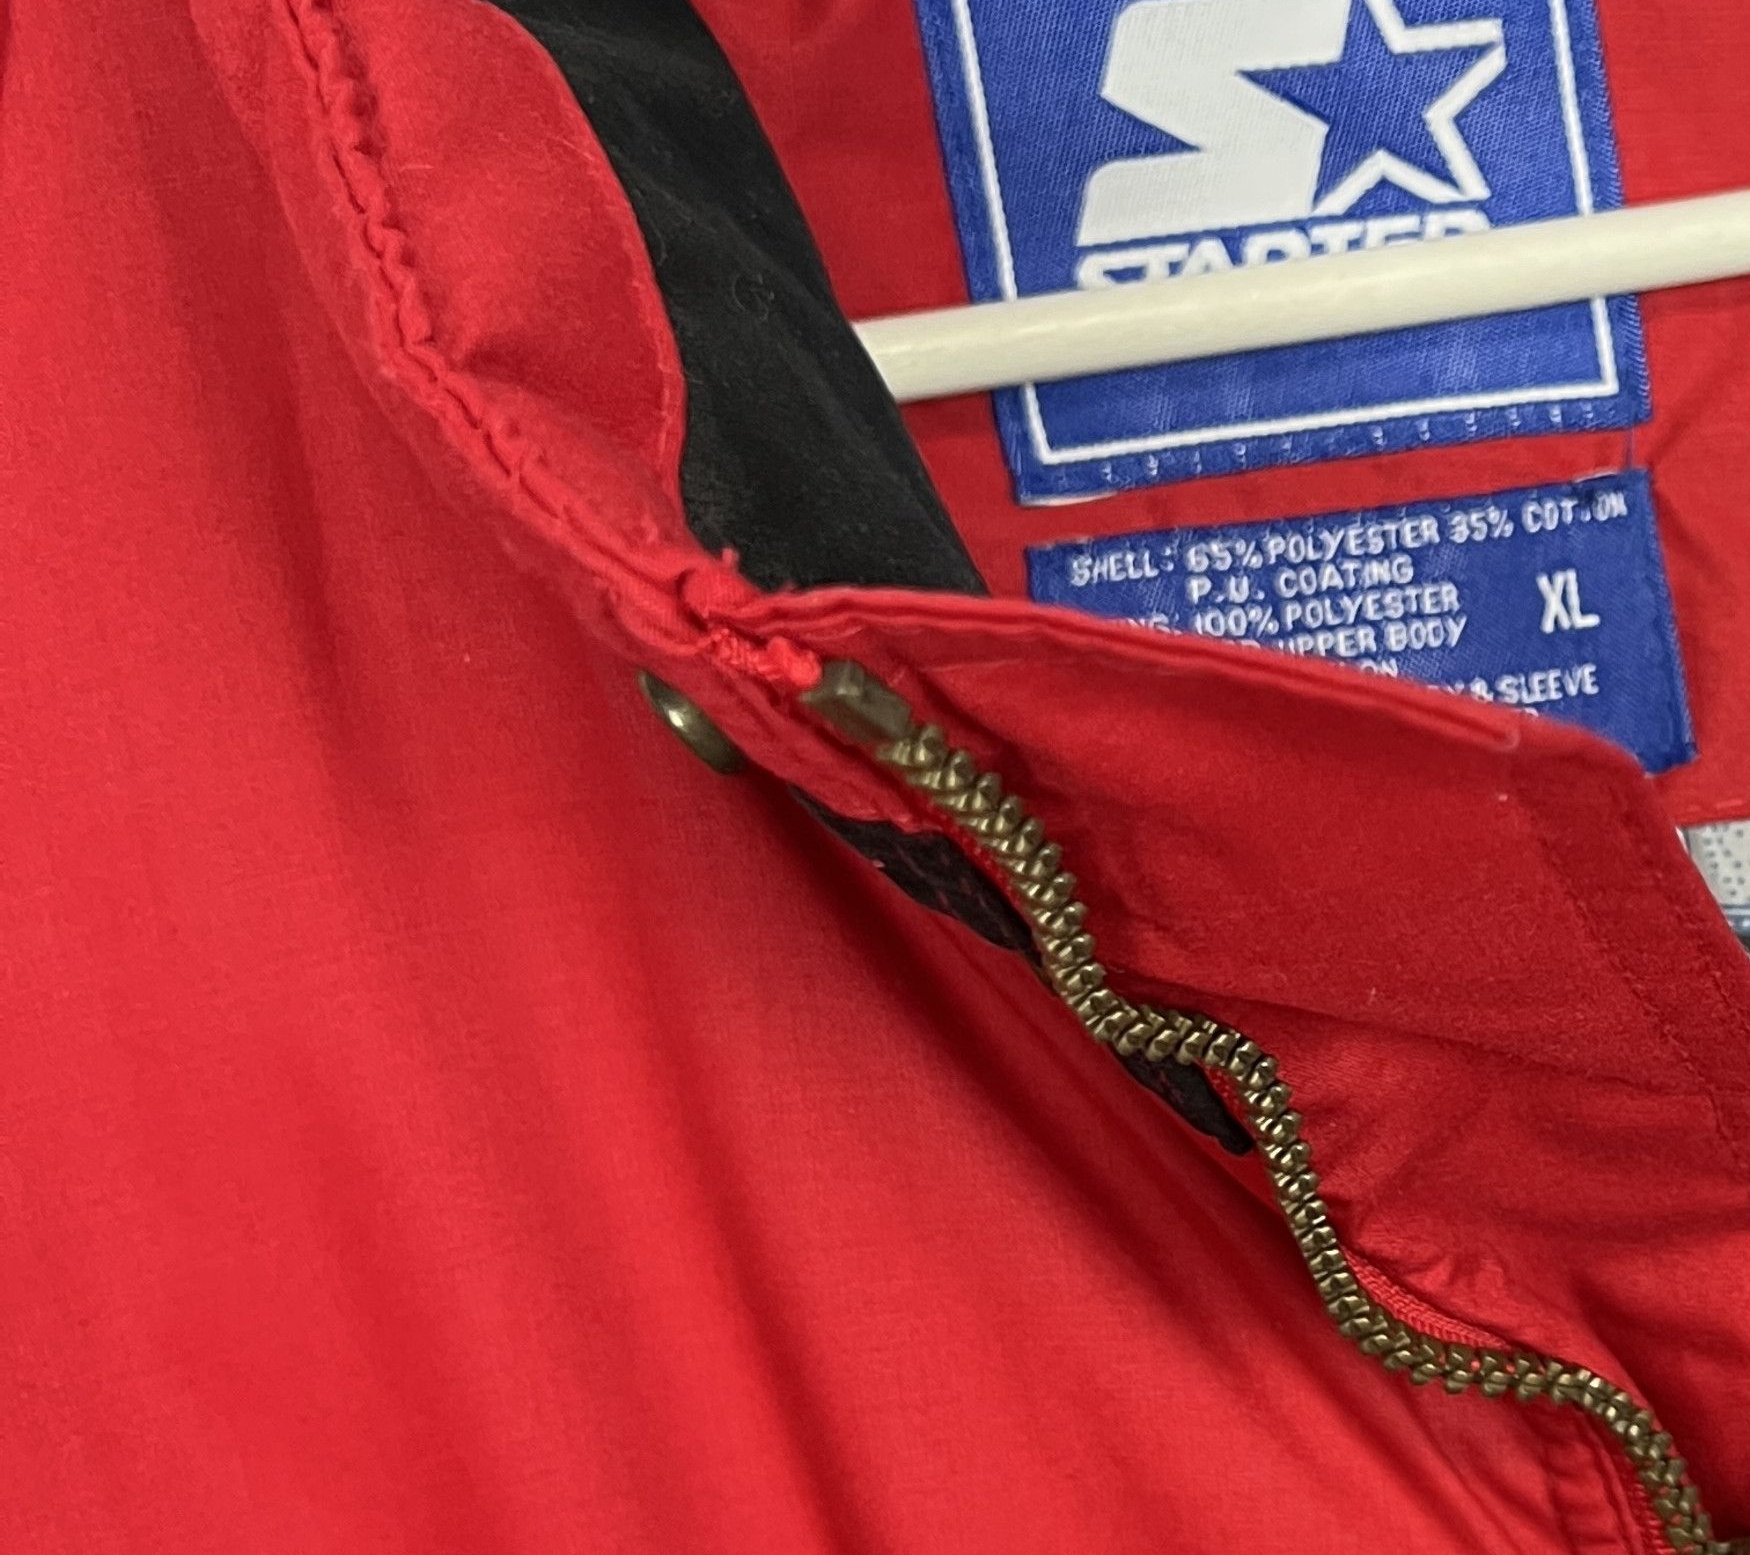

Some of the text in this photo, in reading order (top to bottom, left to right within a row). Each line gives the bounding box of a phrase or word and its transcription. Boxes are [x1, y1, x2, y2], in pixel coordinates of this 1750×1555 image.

[1185, 538, 1264, 573] 65%
[1264, 515, 1441, 565] POLYESTER
[1449, 504, 1515, 544] 35%
[1275, 552, 1414, 599] COATING
[1535, 567, 1601, 635] XL
[1193, 603, 1280, 639] 100%
[1281, 580, 1461, 632] POLYESTER
[1383, 614, 1468, 653] BODY
[1495, 662, 1600, 705] SLEEVE
